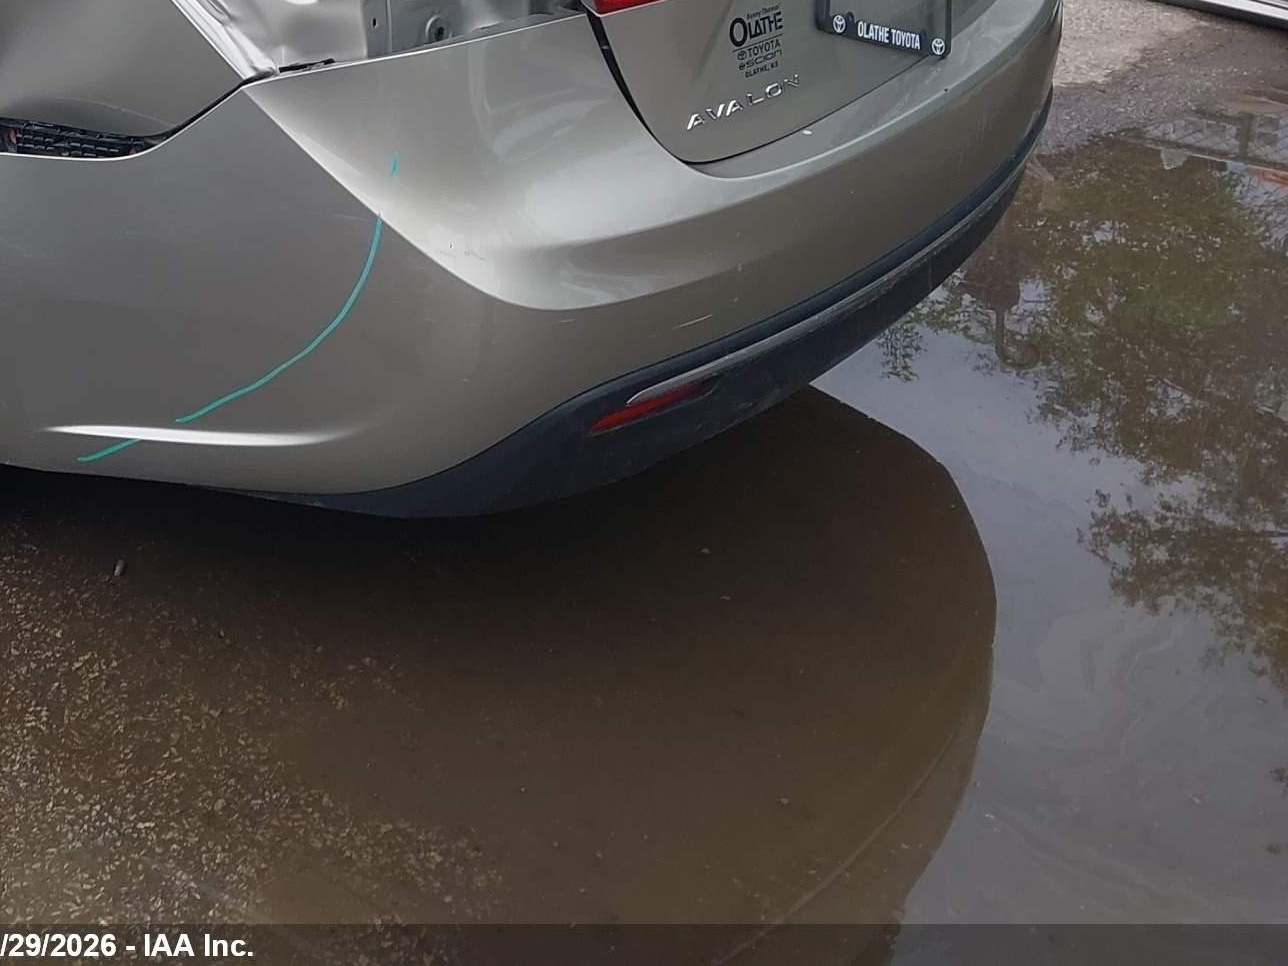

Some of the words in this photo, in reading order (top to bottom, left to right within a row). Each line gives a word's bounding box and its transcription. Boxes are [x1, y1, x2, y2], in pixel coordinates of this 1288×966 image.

[730, 10, 784, 48] OLATHE
[857, 21, 890, 43] OLATHE
[890, 29, 921, 51] TOYOTA
[747, 39, 781, 57] TOYOTA
[687, 74, 799, 131] AVALON
